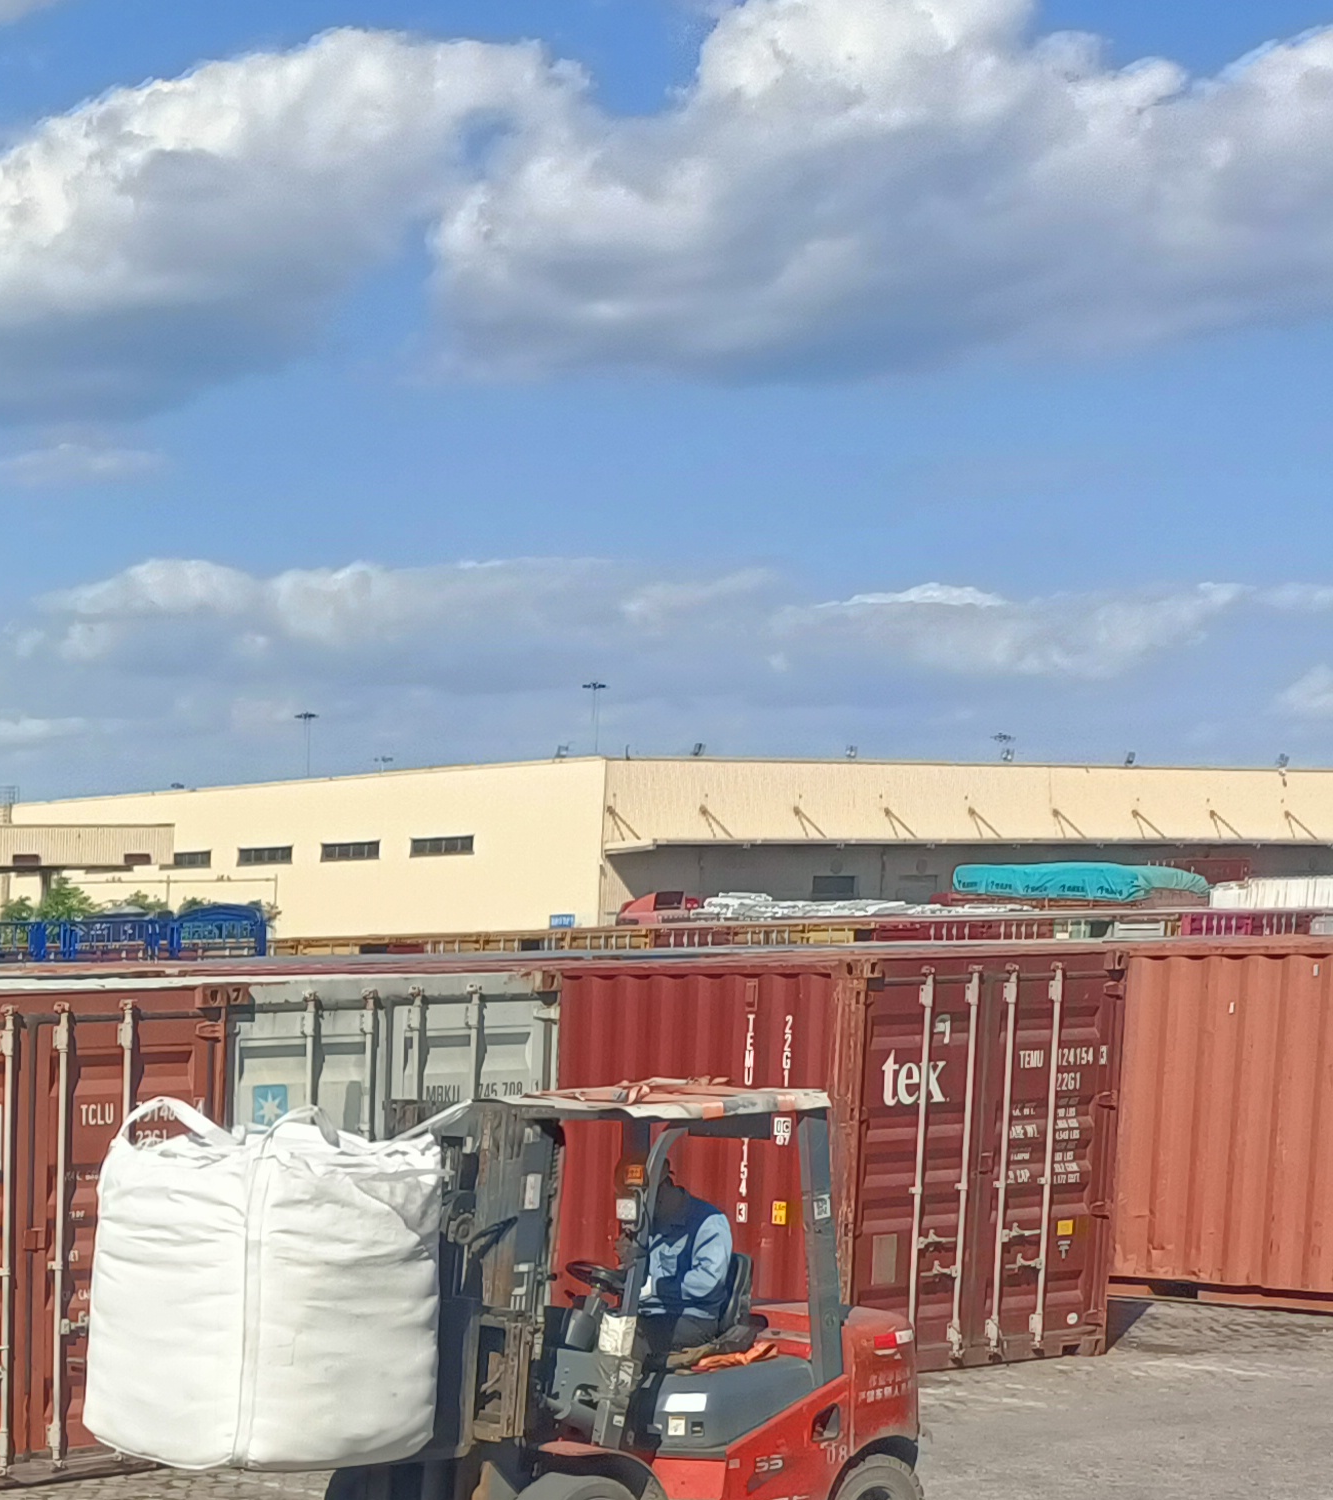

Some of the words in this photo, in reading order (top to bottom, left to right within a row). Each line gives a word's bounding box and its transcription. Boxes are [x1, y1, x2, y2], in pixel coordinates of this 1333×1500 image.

[743, 1013, 756, 1086] TEMU
[782, 1015, 793, 1088] 22G1
[1019, 1050, 1044, 1069] TEMU
[1058, 1047, 1093, 1066] 124154
[1099, 1045, 1108, 1065] 3
[881, 1049, 946, 1106] tex
[1056, 1072, 1080, 1091] 22G1
[80, 1104, 114, 1126] TCLU
[737, 1203, 747, 1223] 3
